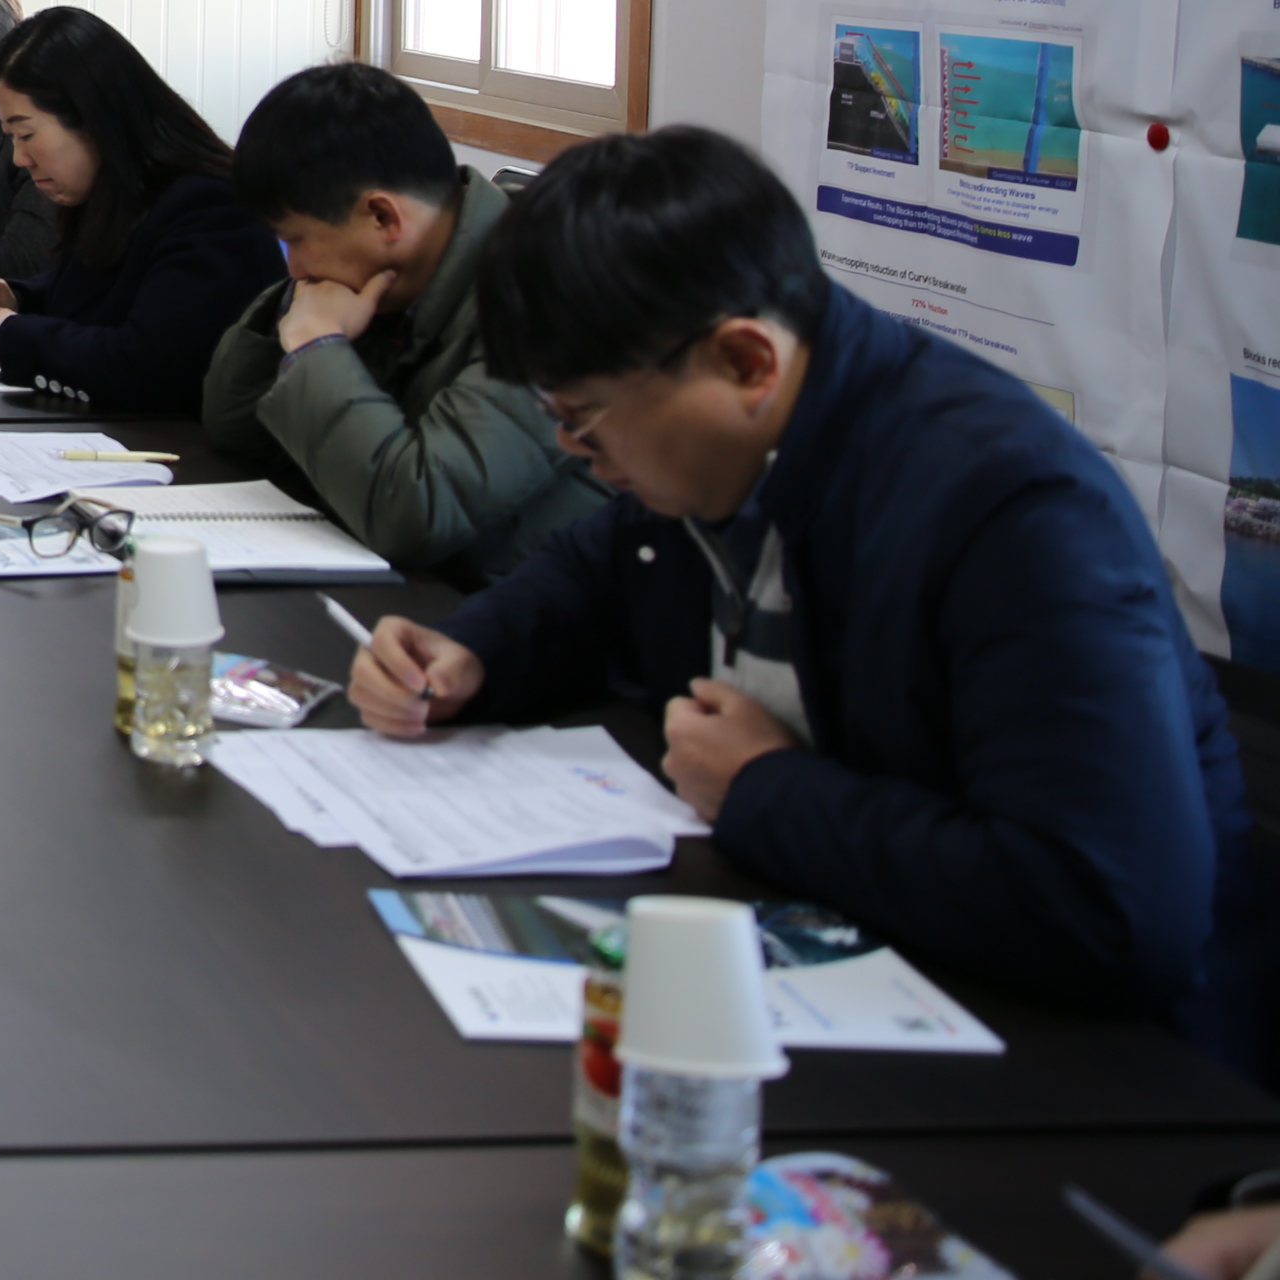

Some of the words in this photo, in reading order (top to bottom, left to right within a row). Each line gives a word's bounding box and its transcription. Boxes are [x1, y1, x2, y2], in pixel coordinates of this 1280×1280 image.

[1009, 188, 1036, 200] Waves
[1012, 232, 1033, 242] wave
[911, 298, 926, 308] 72%
